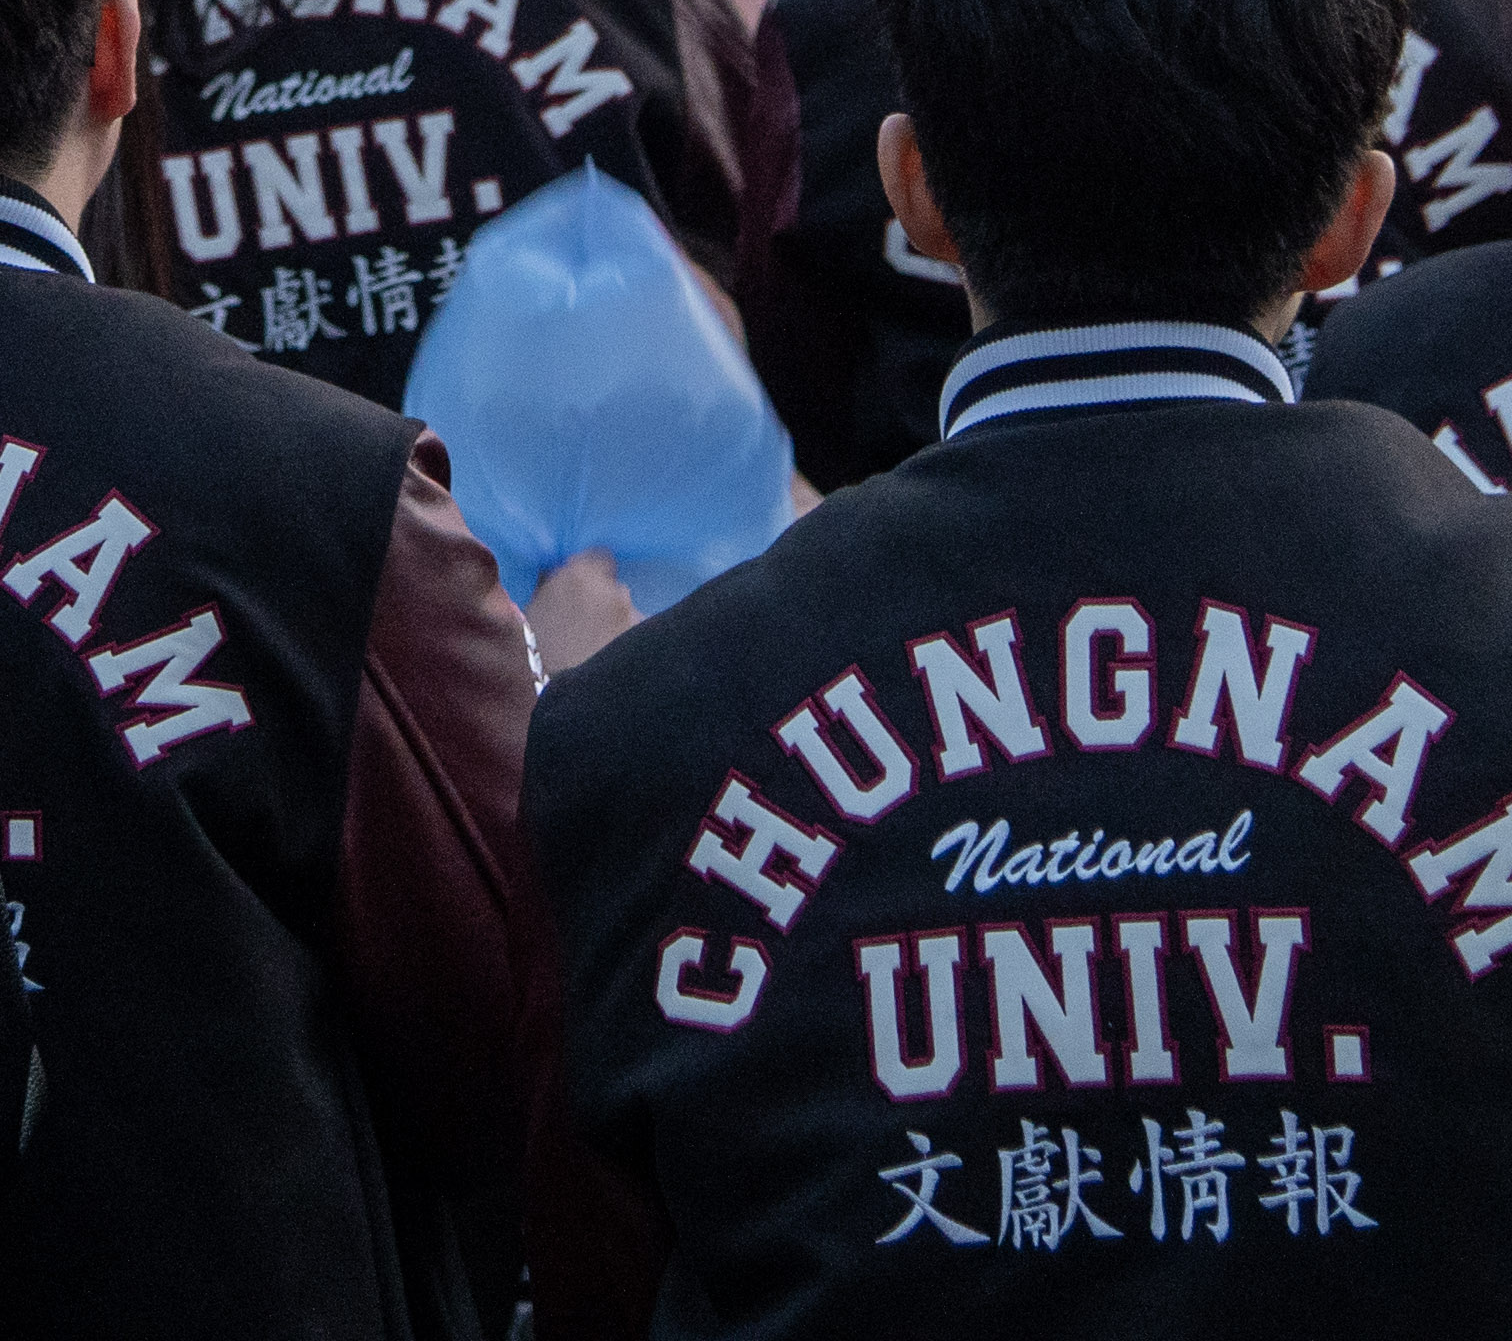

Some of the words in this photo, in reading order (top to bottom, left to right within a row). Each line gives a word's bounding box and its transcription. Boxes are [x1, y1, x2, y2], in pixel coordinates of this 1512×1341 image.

[201, 47, 414, 122] National
[160, 108, 504, 263] UNIV.
[930, 809, 1254, 895] National
[853, 905, 1372, 1104] UNIV.
[874, 1107, 1380, 1251] 文獻情報
